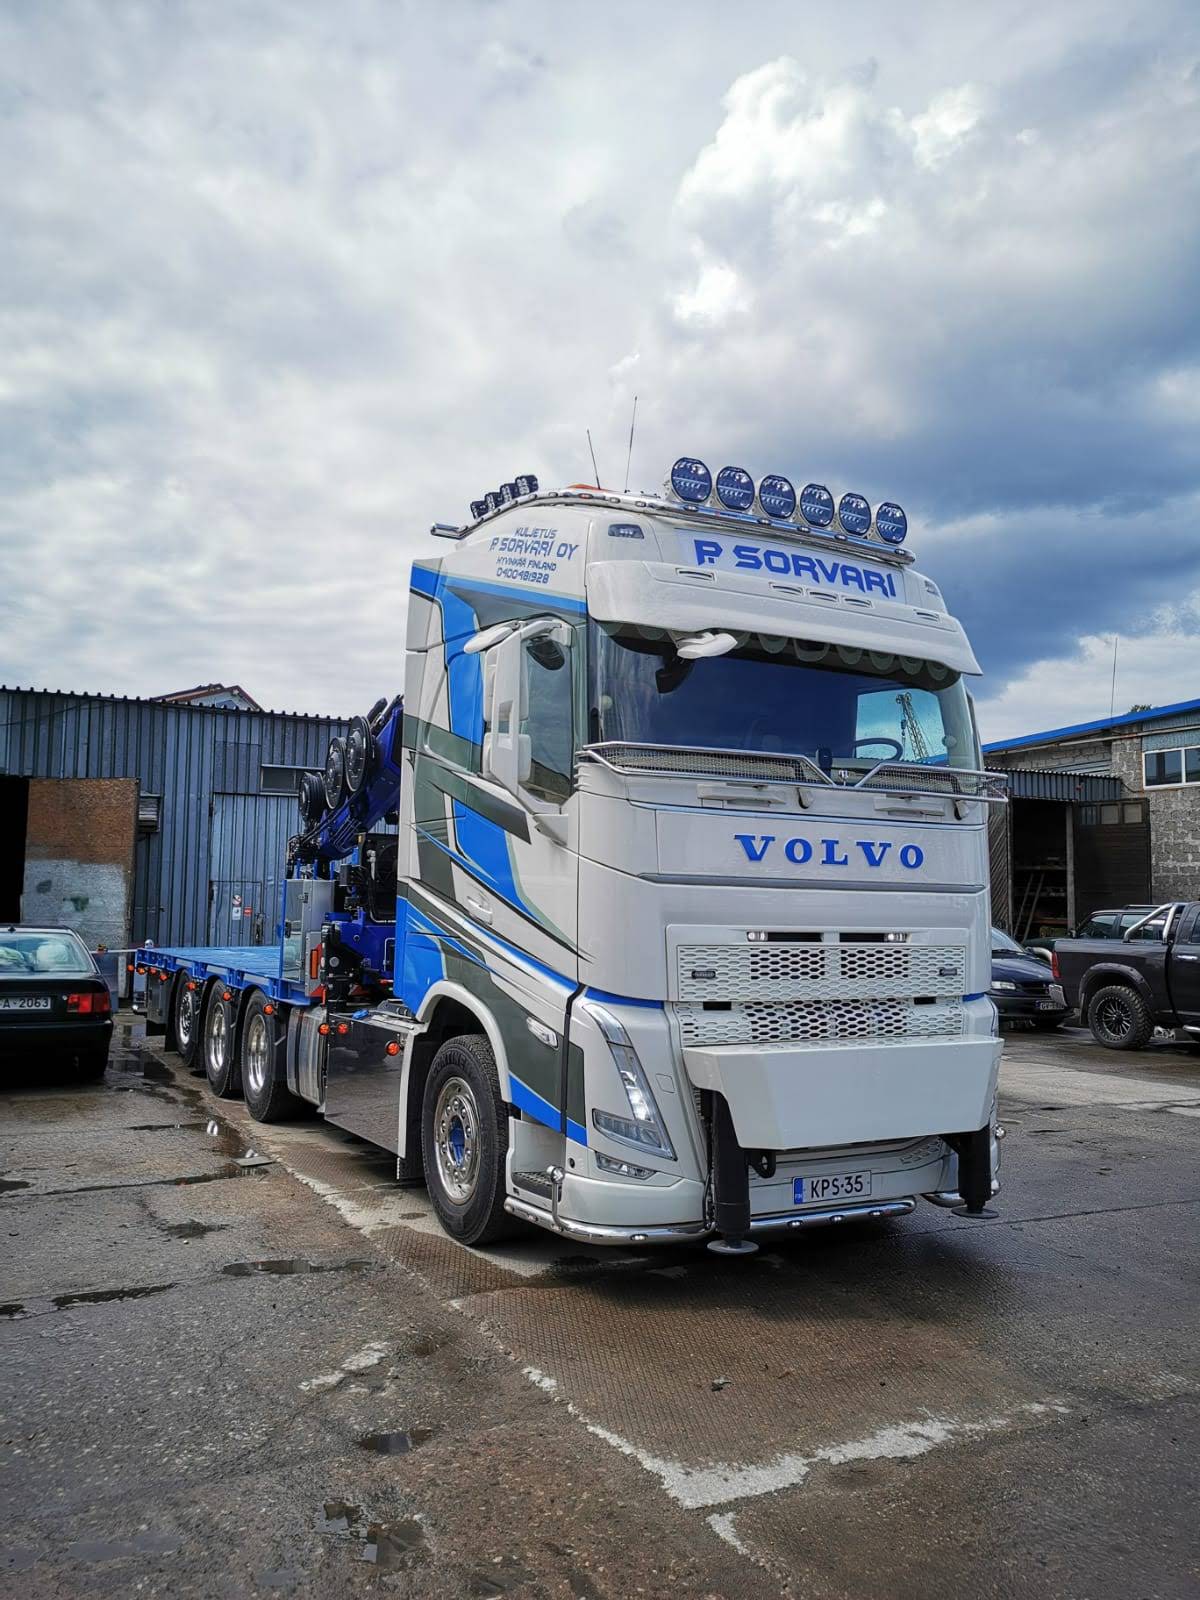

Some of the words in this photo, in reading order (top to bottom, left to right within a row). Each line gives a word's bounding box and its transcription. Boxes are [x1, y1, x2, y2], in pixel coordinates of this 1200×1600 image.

[514, 527, 558, 539] KULJETUS
[499, 538, 555, 558] SORVARI
[556, 542, 580, 560] OY
[496, 567, 550, 584] 0400481928
[527, 559, 557, 572] FINLAND
[732, 544, 897, 598] SORVARI
[734, 834, 925, 870] VOLVO
[811, 1174, 864, 1198] KPS-35
